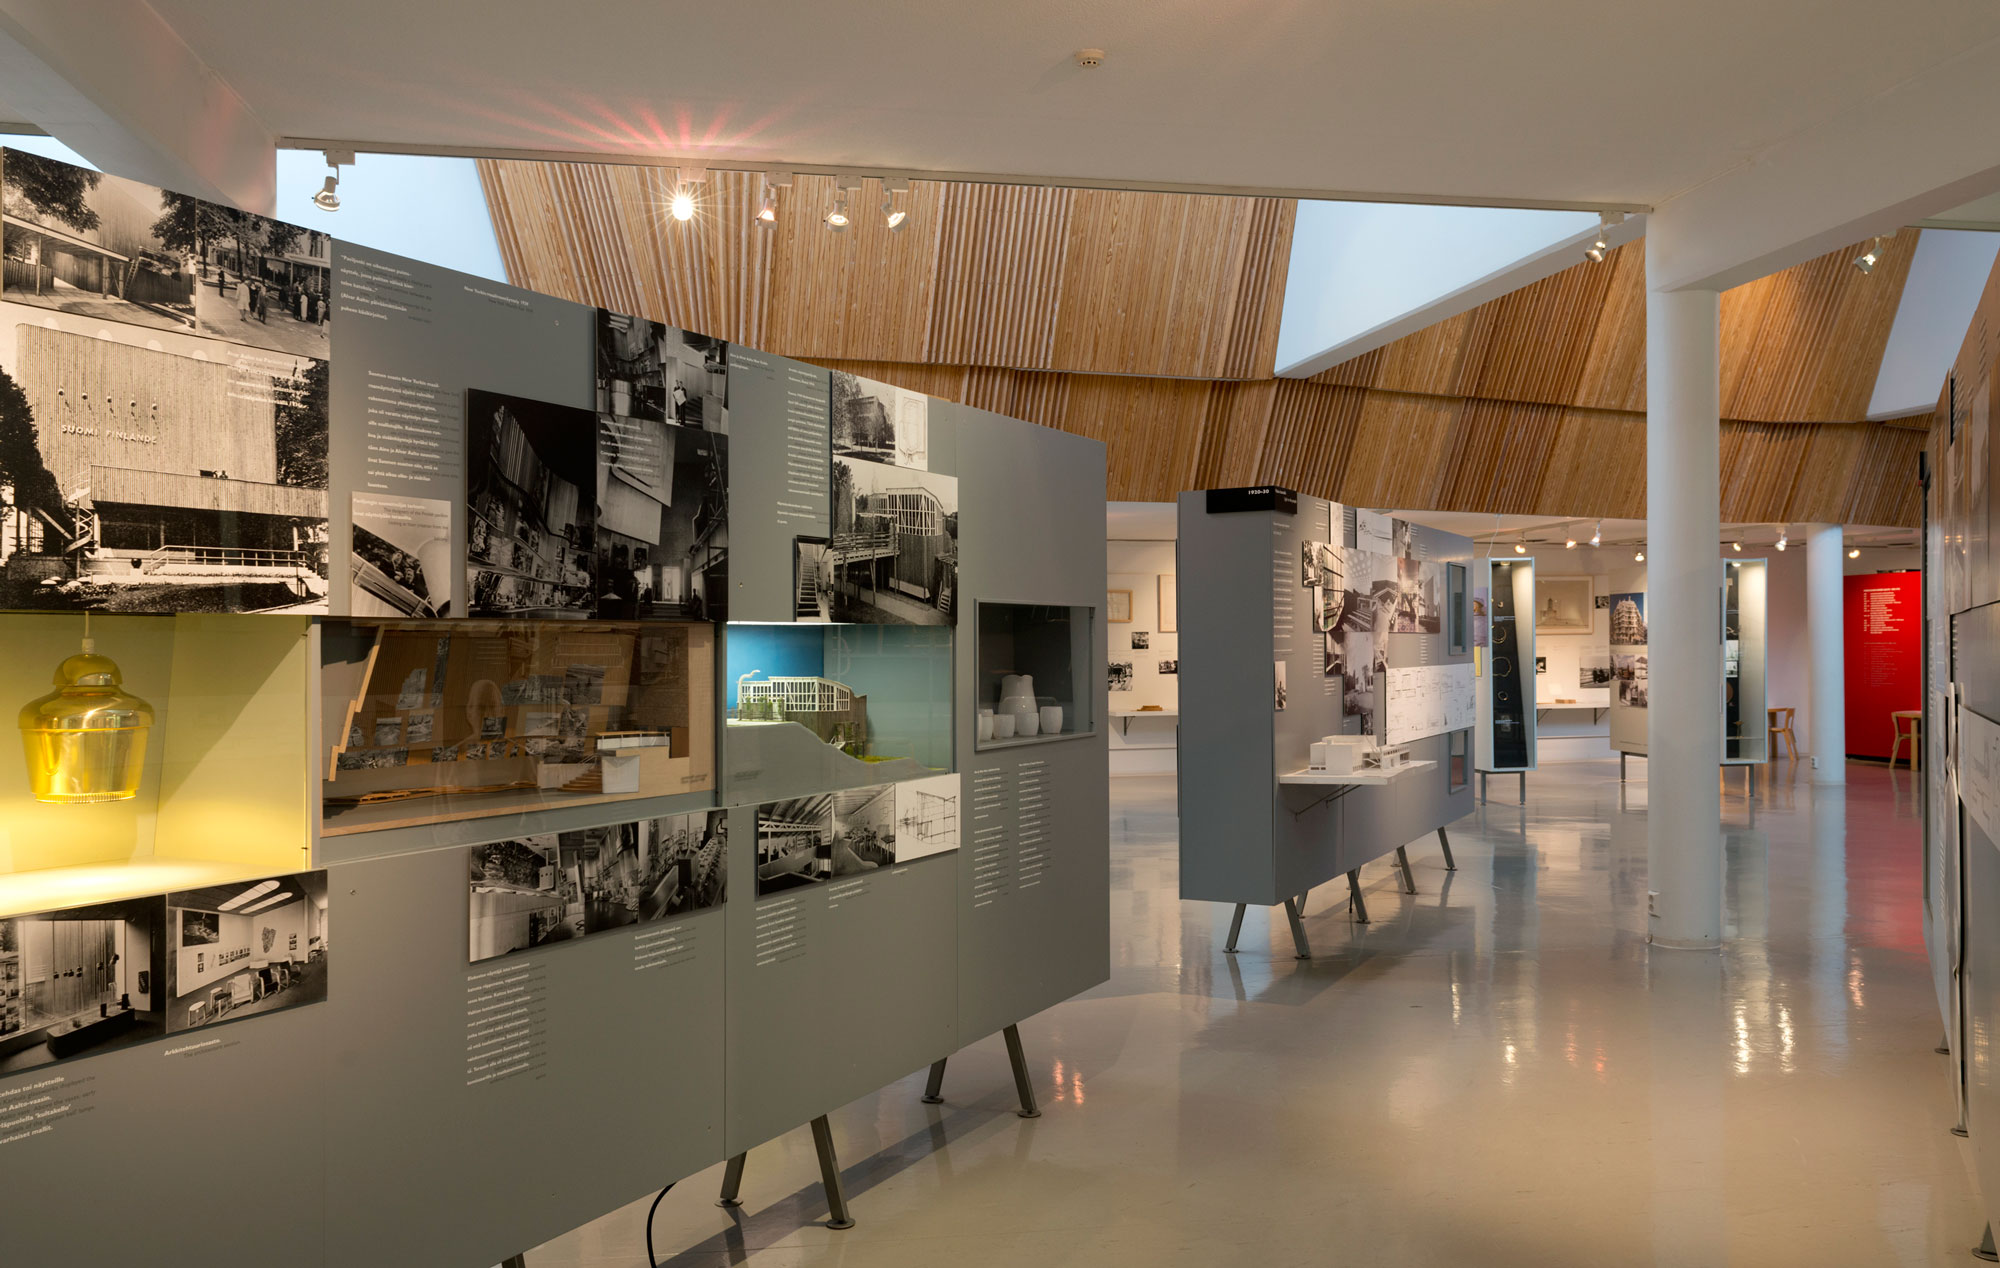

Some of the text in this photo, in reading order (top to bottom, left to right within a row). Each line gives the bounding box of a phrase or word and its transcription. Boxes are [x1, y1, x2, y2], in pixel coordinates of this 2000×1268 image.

[61, 424, 157, 445] SUOMI FINLANDE
[23, 1084, 32, 1092] toi
